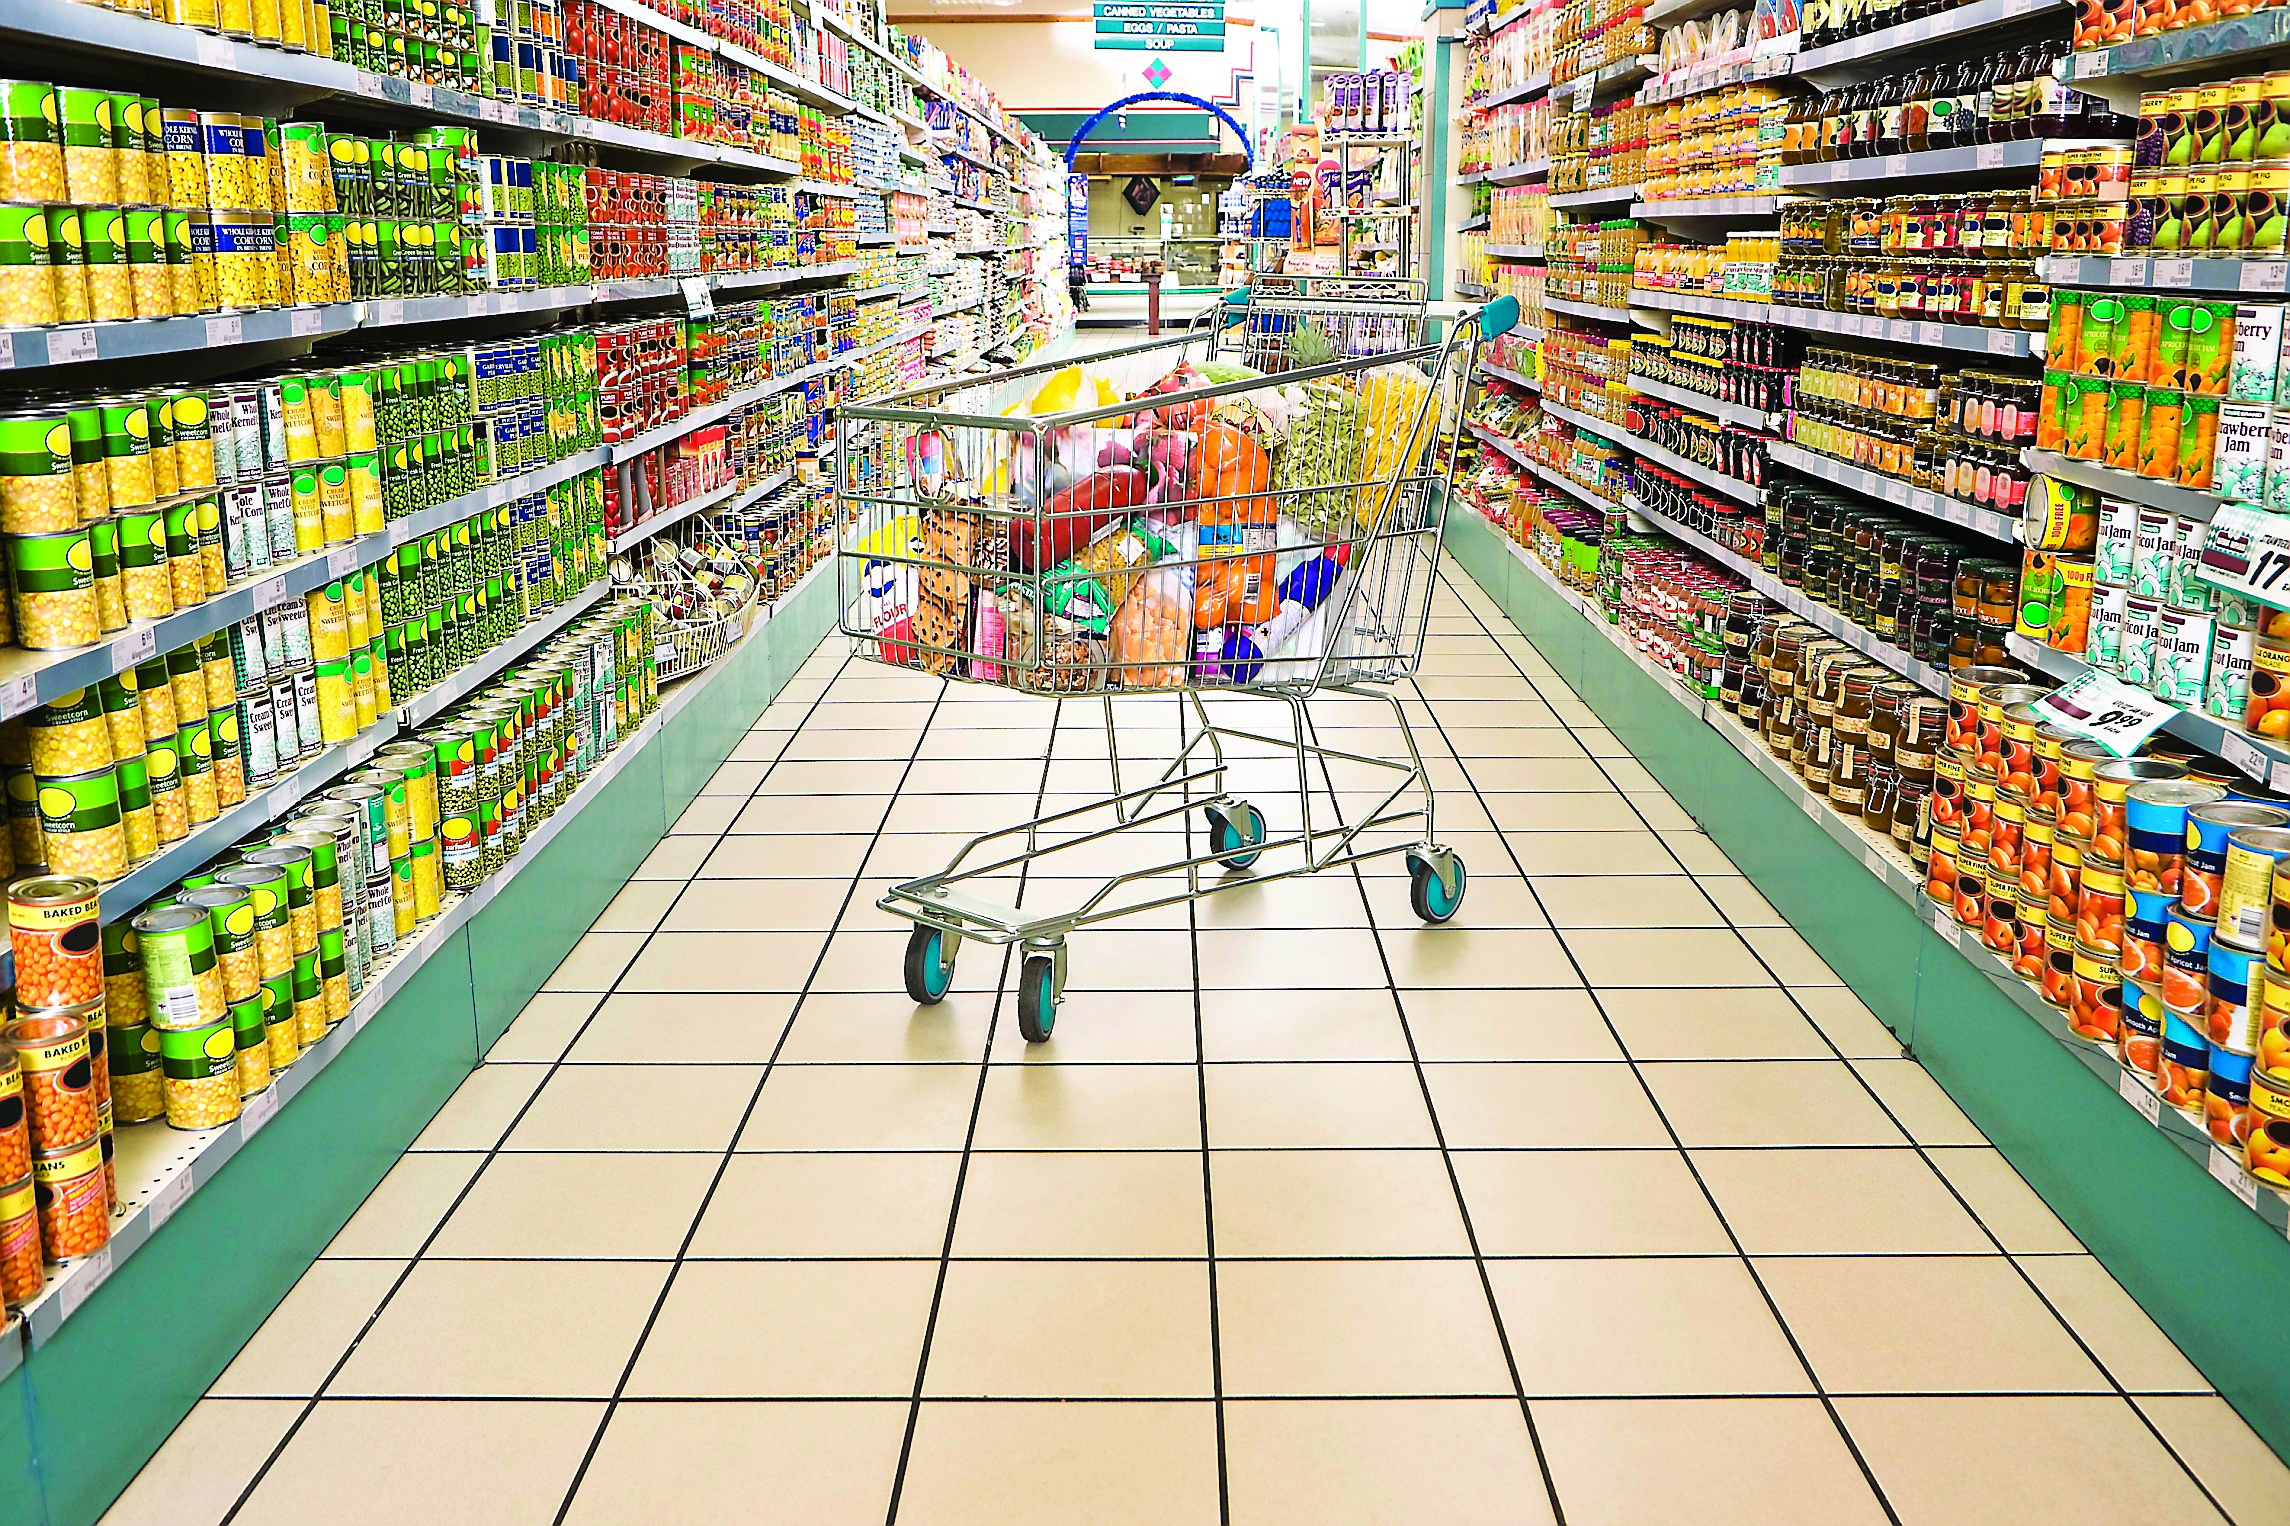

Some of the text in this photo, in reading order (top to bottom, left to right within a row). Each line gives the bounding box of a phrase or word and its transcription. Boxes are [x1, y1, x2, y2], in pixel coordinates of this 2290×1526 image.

[1103, 6, 1215, 18] CANNED VEGETABLES
[1123, 23, 1198, 34] EGGS / PASTA
[1145, 40, 1174, 49] SOUP
[164, 135, 193, 144] CORN
[1293, 178, 1311, 186] NEW
[210, 410, 230, 422] Whole
[175, 429, 208, 438] Sweetcorn
[2224, 436, 2250, 453] Jam
[269, 486, 290, 498] Whole
[2052, 503, 2064, 538] 100g FREE
[2110, 527, 2131, 539] Jam
[2067, 570, 2084, 582] 100g
[873, 603, 907, 629] FLOUR
[2100, 608, 2121, 623] Jam
[2174, 638, 2200, 653] Jam
[2226, 655, 2252, 670] Jam
[1957, 686, 1968, 694] FINE
[46, 710, 88, 721] Sweetcorn
[2006, 722, 2016, 731] FINE
[2103, 725, 2121, 734] EACH
[1948, 764, 1961, 772] FINE
[1958, 857, 1987, 870] SUPER FINE
[2200, 861, 2215, 872] Jam
[1990, 881, 2006, 891] SUPER
[369, 886, 389, 899] Whole
[1990, 888, 2008, 898] APRICOT
[43, 906, 82, 919] BAKED
[2050, 930, 2067, 941] SUPER
[2169, 956, 2194, 969] Apricot
[2125, 1015, 2147, 1031] Smooth
[44, 1043, 81, 1059] BAKED
